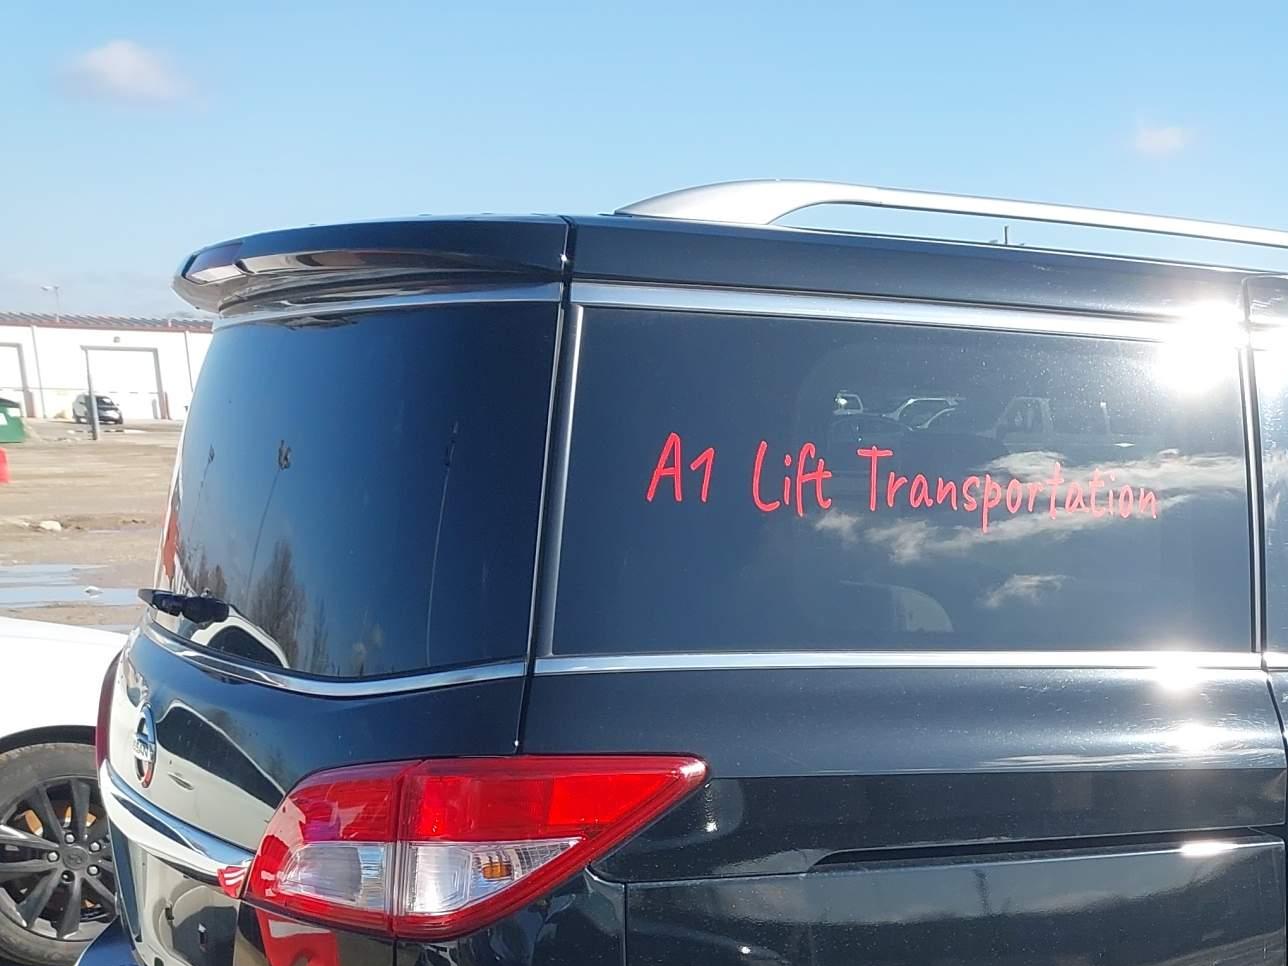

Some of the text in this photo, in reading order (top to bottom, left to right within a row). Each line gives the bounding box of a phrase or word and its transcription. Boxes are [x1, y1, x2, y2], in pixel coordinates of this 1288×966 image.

[646, 432, 1157, 533] A1 Lift Transportation
